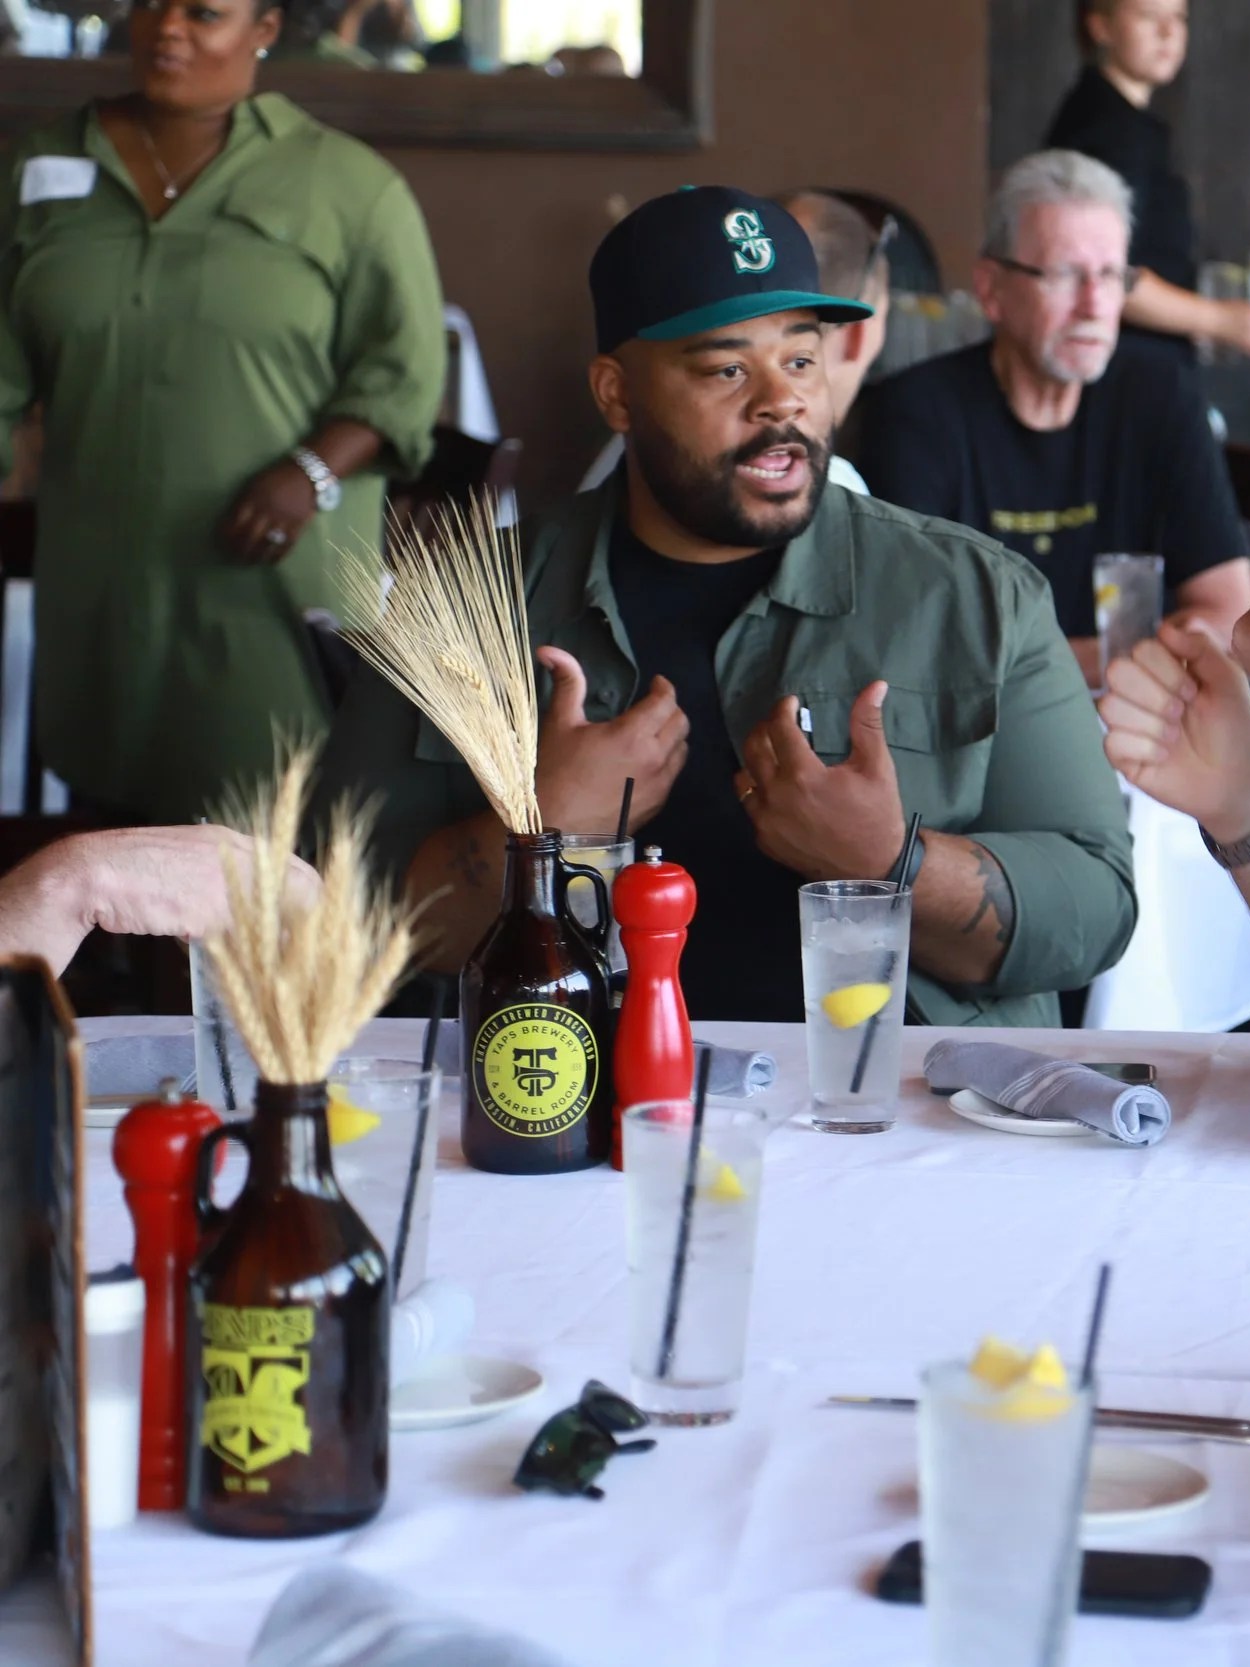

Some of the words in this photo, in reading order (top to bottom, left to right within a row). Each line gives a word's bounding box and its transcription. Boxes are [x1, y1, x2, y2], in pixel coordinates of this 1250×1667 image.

[721, 207, 776, 274] S
[476, 1020, 500, 1063] BRAVELY
[501, 1008, 548, 1024] BREWED
[554, 1010, 584, 1034] SINCE
[492, 1030, 517, 1055] TAPS
[521, 1025, 579, 1053] BREWERY
[498, 1092, 546, 1116] BARREL
[551, 1081, 578, 1110] ROOM
[527, 1094, 588, 1133] CALIFORNIA
